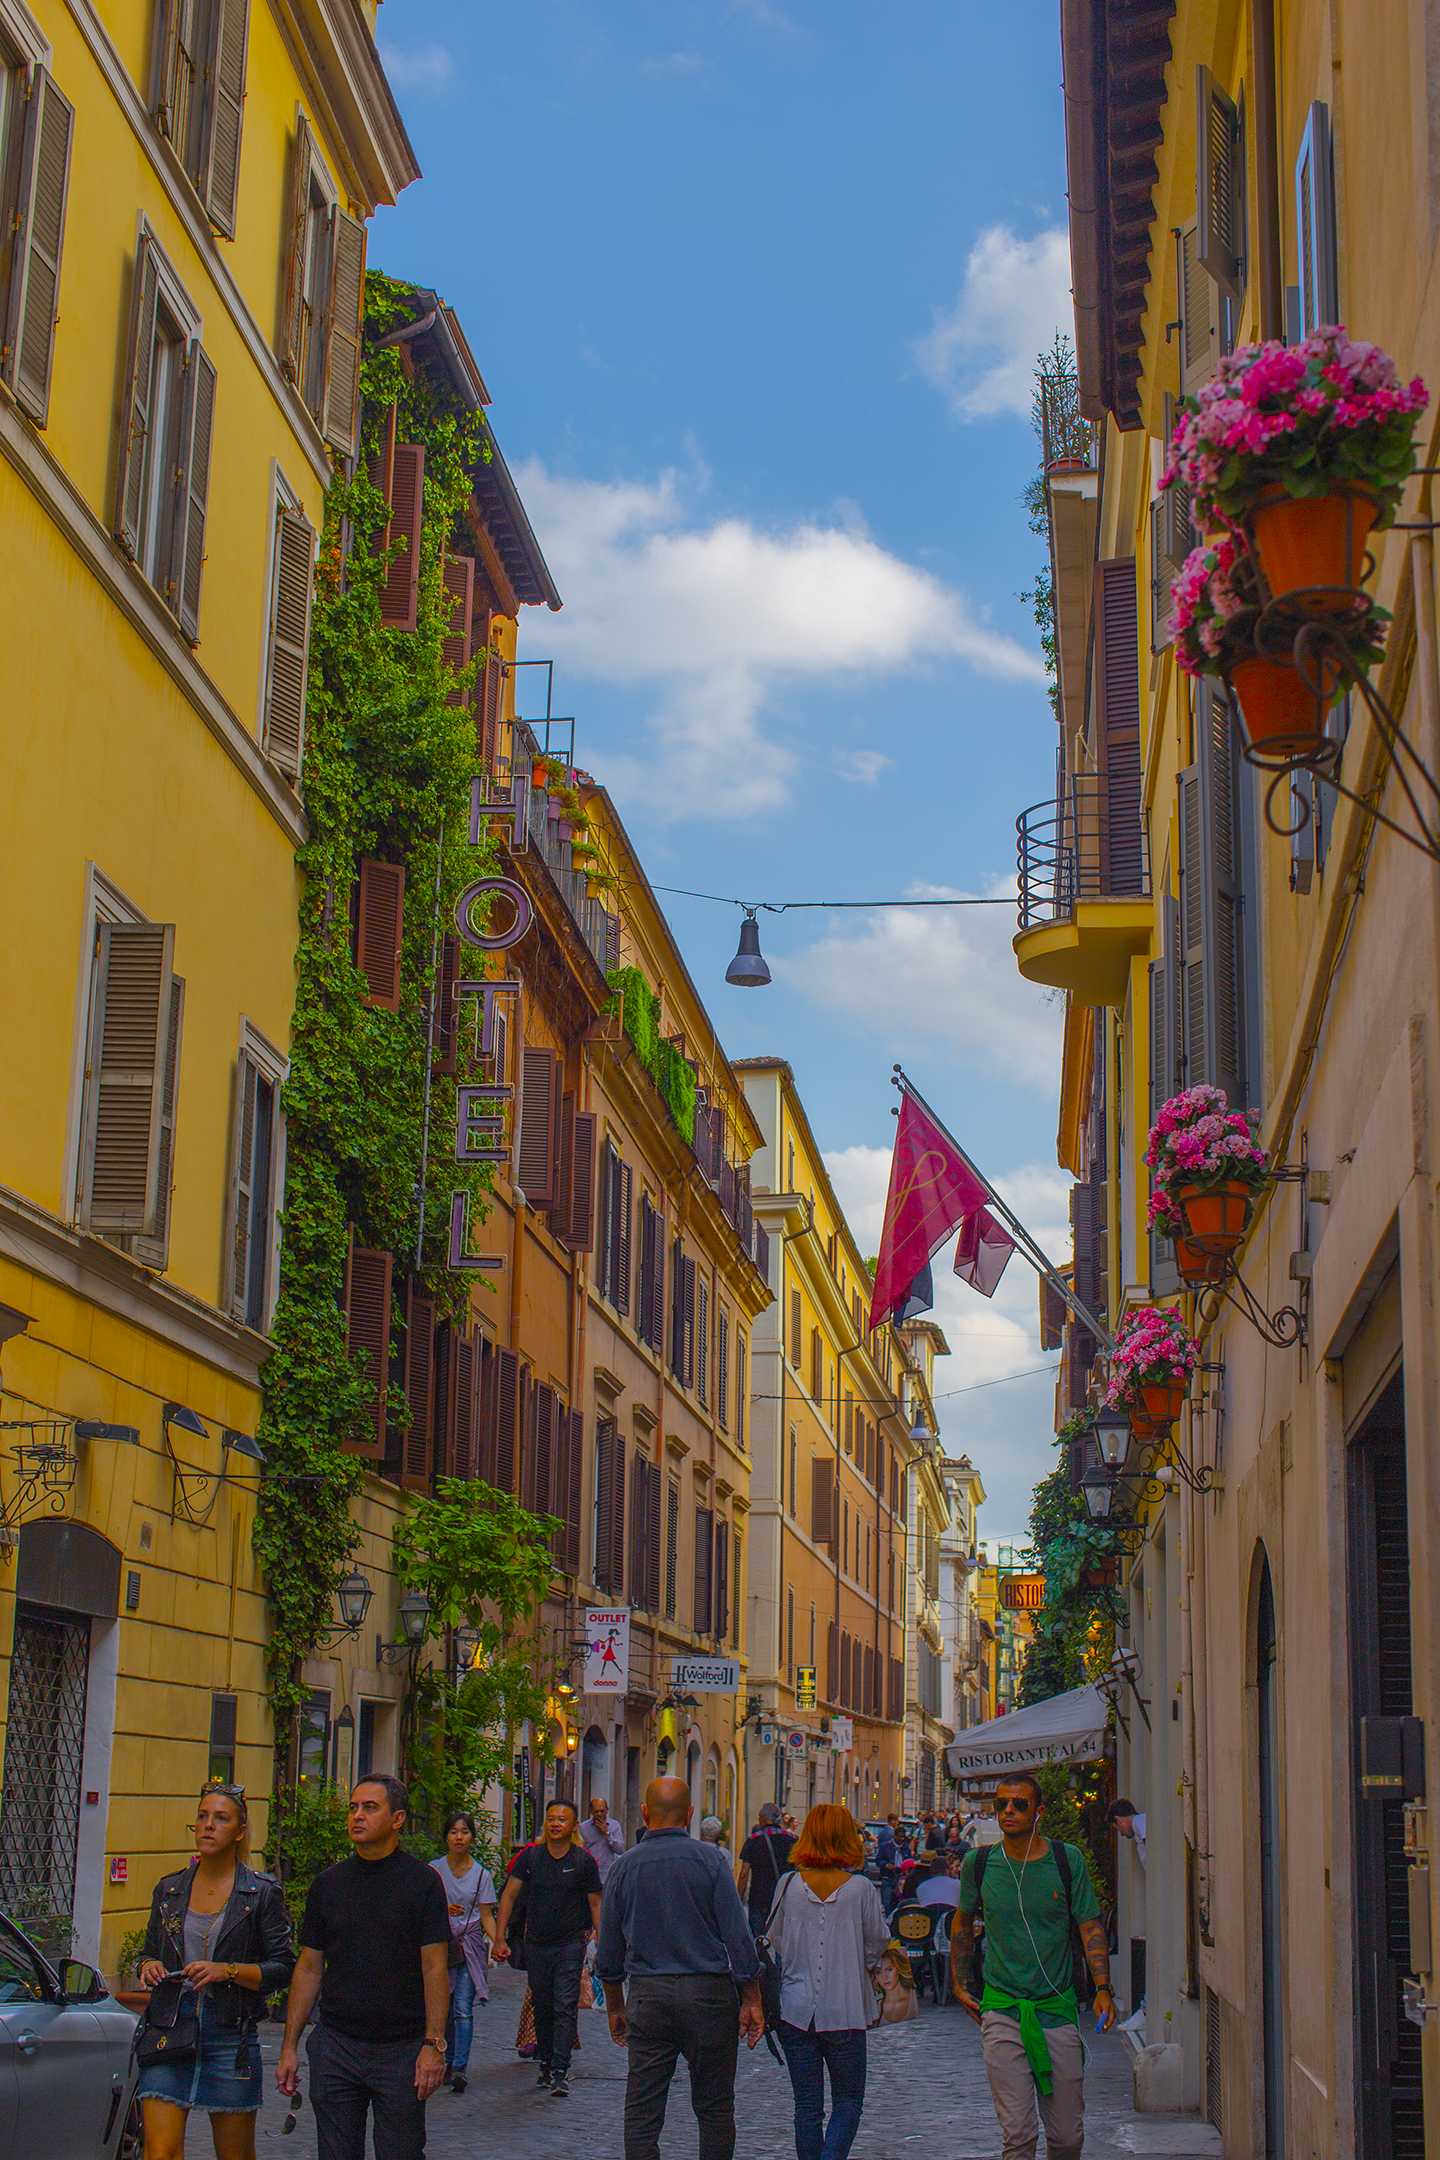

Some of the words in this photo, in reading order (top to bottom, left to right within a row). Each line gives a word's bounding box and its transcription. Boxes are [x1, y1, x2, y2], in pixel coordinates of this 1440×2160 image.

[447, 775, 533, 1272] HOTEL
[589, 1613, 627, 1623] OUTLET
[686, 1669, 724, 1680] Wolford
[799, 1668, 814, 1685] T
[593, 1679, 618, 1687] donna
[958, 1745, 1057, 1769] RISTORANTE
[1082, 1740, 1096, 1754] 34
